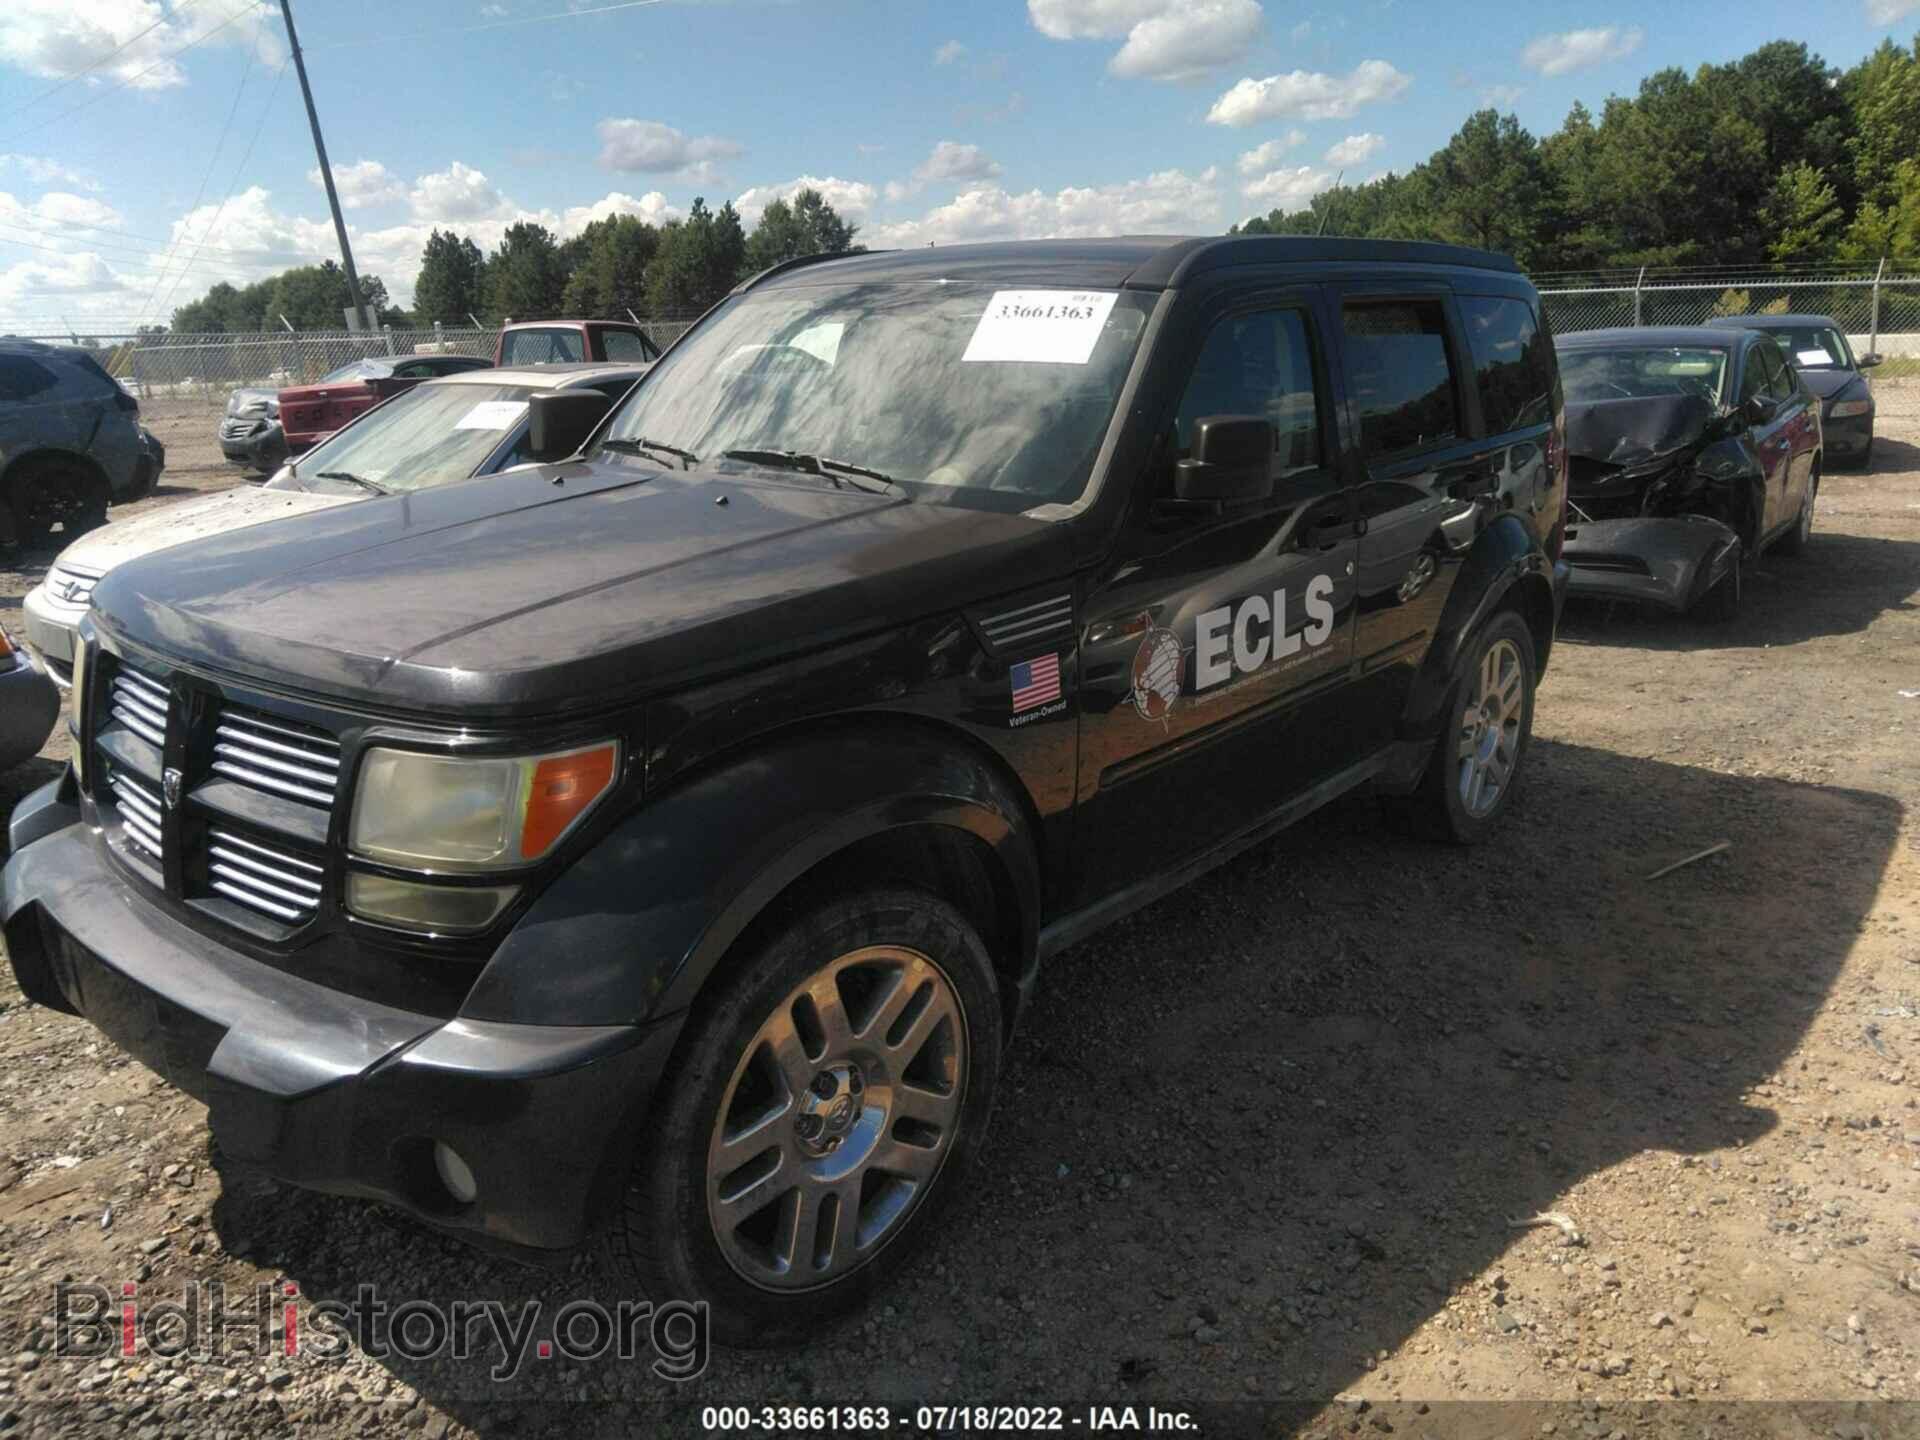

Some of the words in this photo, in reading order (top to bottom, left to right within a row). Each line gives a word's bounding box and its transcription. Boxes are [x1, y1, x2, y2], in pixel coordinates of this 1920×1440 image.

[995, 304, 1094, 320] 33661363
[1195, 573, 1335, 691] ECLS
[1008, 699, 1067, 728] Veteran-Owned
